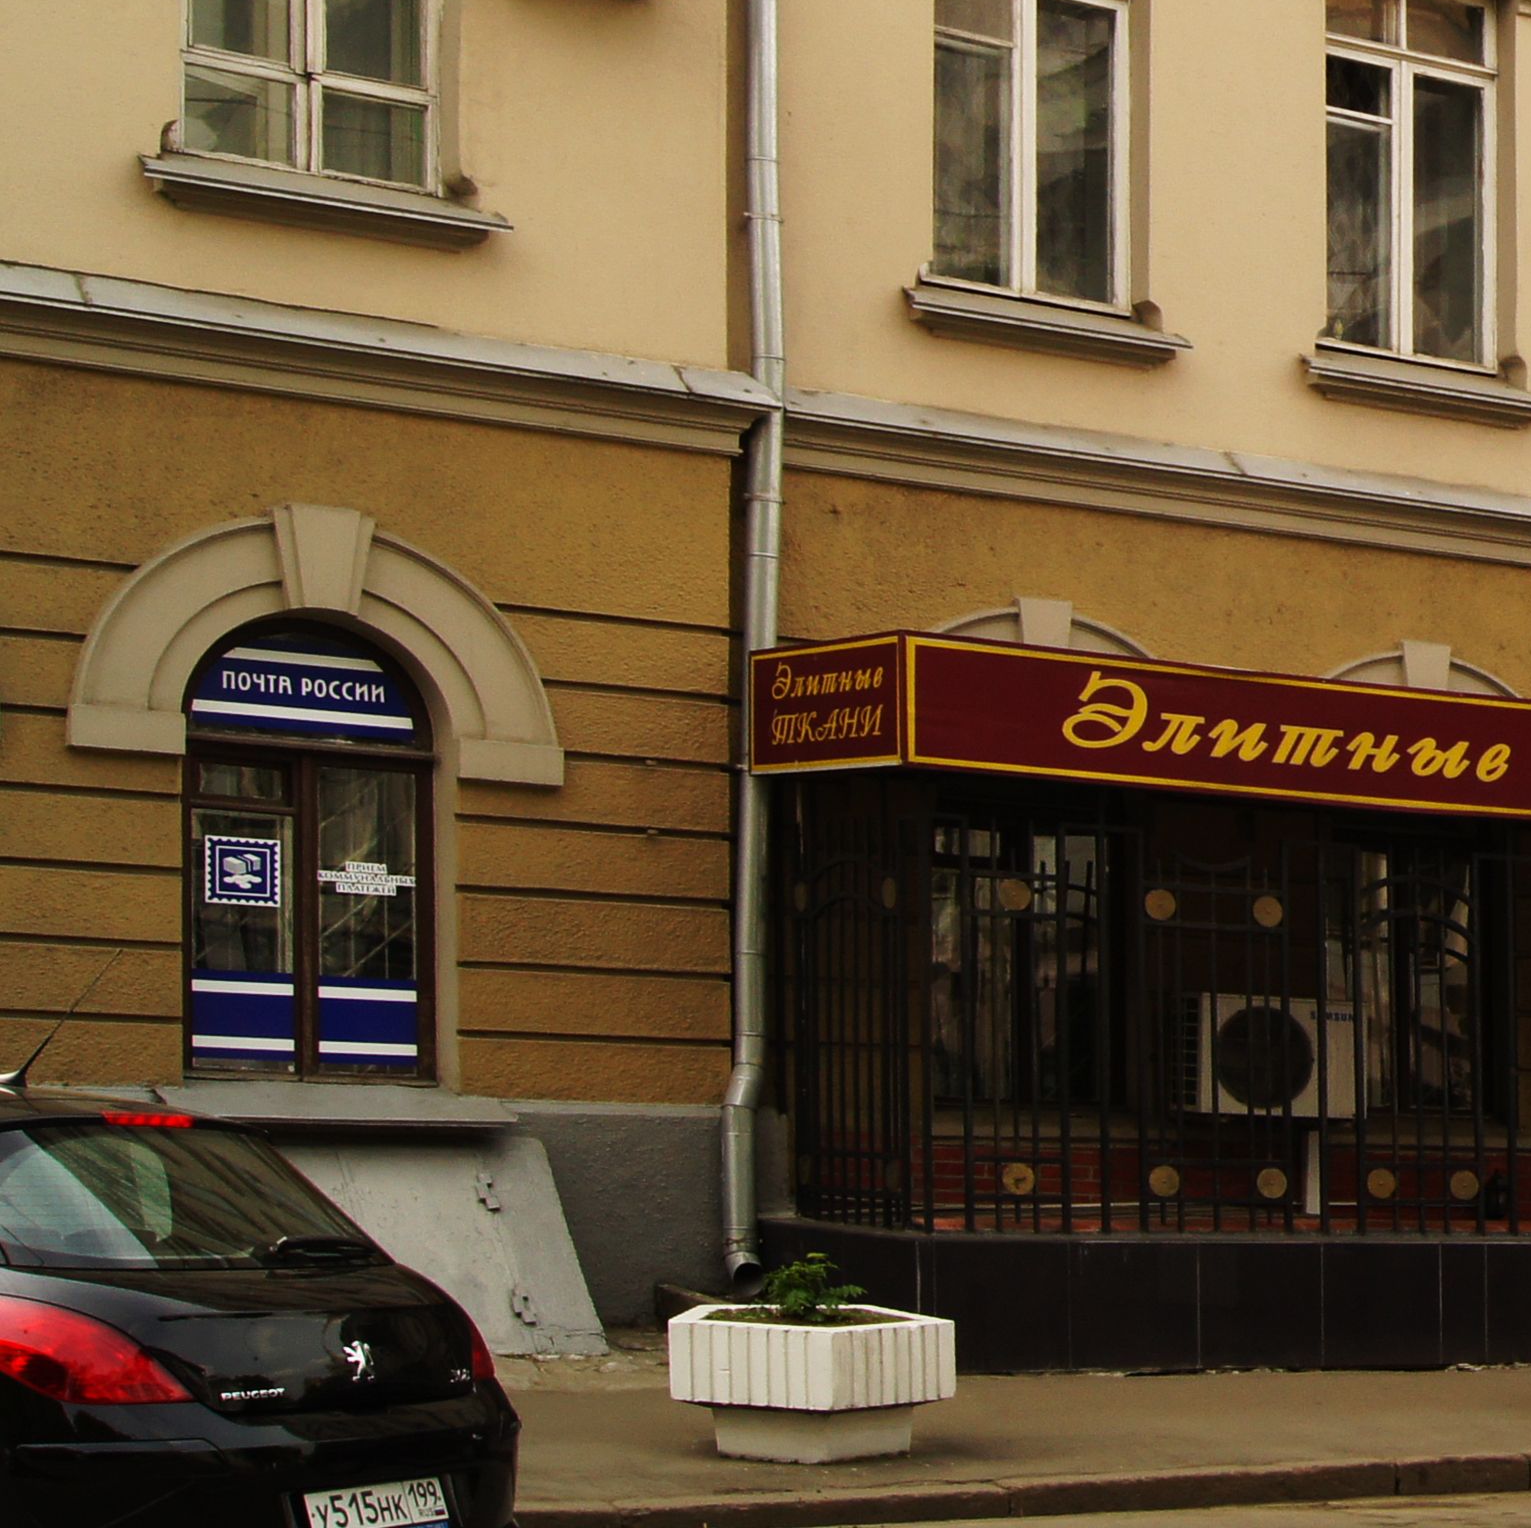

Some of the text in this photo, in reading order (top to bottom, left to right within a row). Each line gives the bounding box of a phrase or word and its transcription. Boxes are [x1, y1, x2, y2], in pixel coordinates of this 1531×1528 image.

[221, 670, 385, 703] ПОЧТА РОССИИ
[771, 661, 884, 700] Элитные
[771, 704, 884, 745] ТКАНИ
[1061, 670, 1512, 783] Элитные
[220, 1387, 286, 1401] PEUGEOT
[408, 1480, 438, 1509] 199
